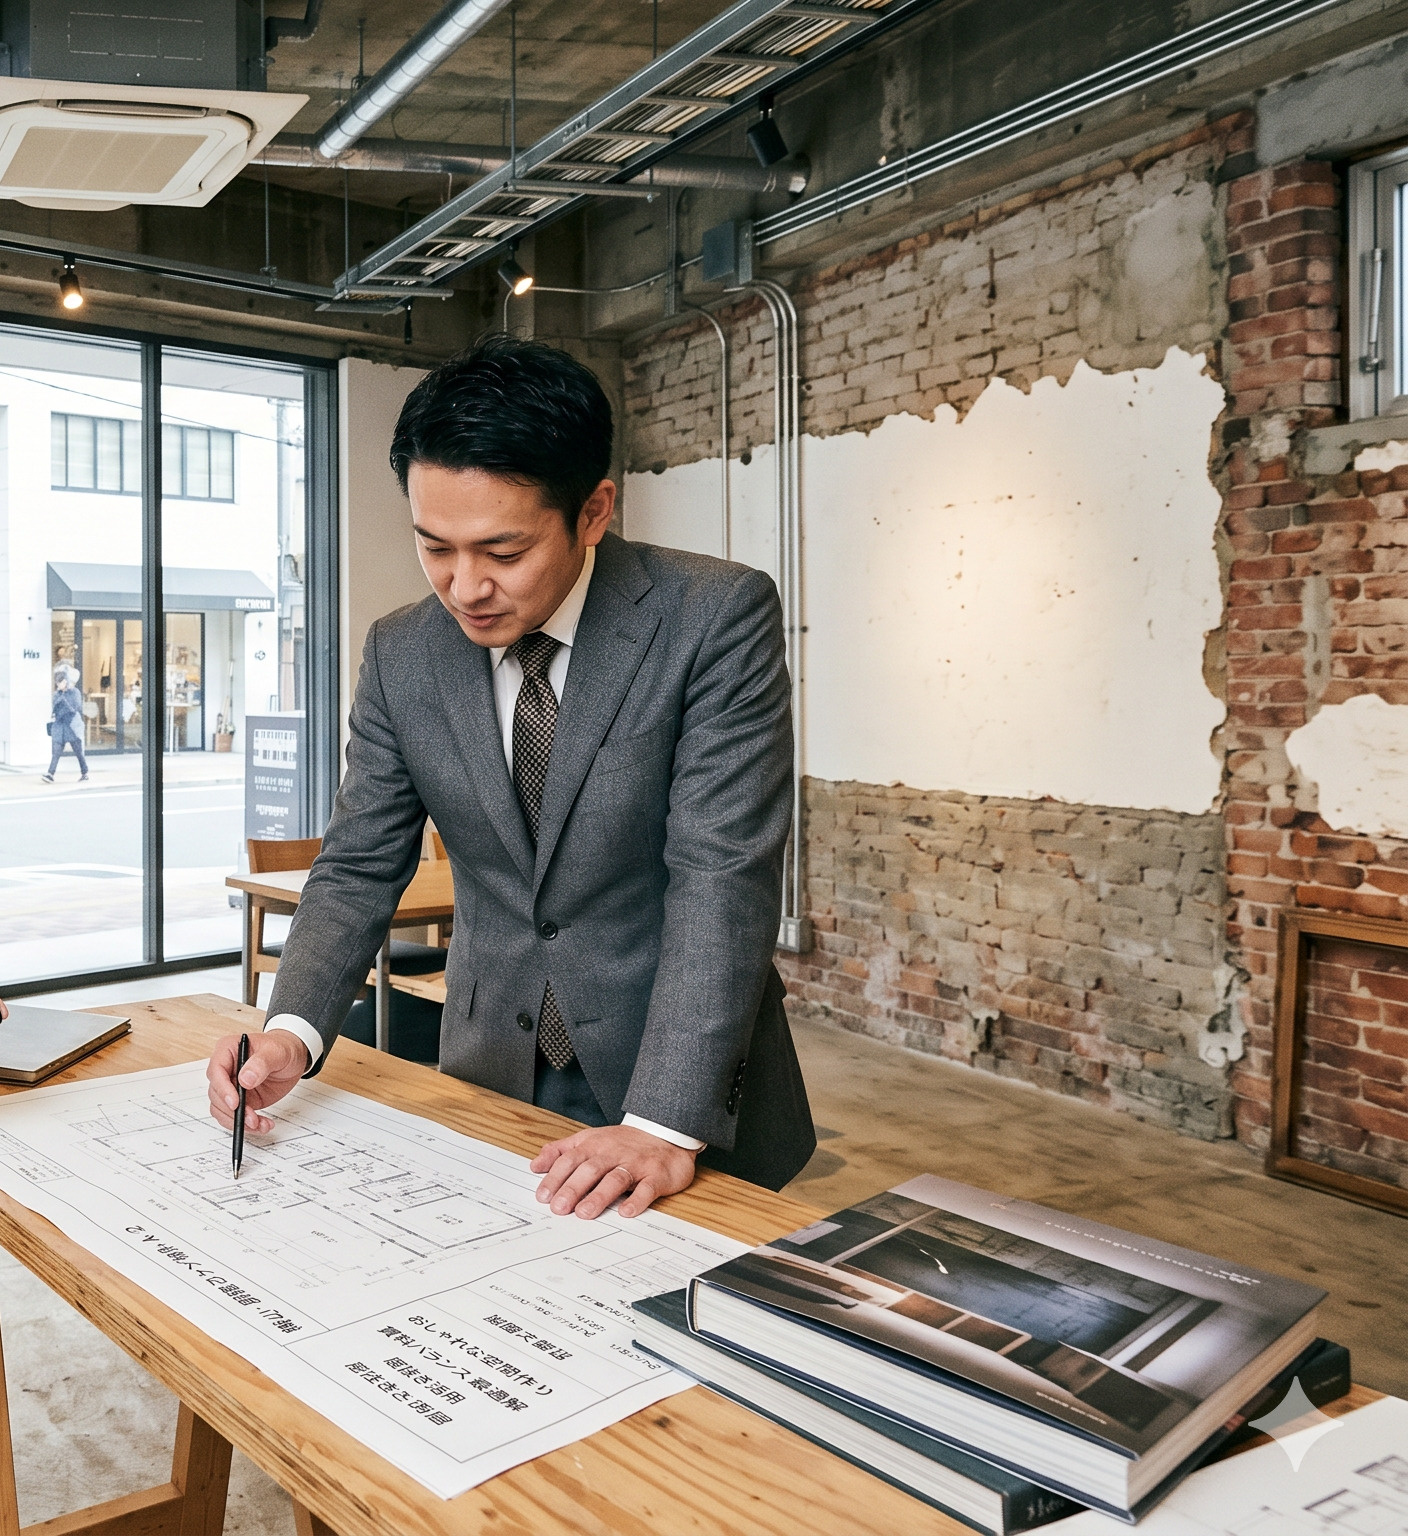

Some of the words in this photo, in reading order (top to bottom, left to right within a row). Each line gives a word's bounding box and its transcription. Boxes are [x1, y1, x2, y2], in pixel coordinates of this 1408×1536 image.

[407, 1314, 554, 1397] おしゃれな空間作り
